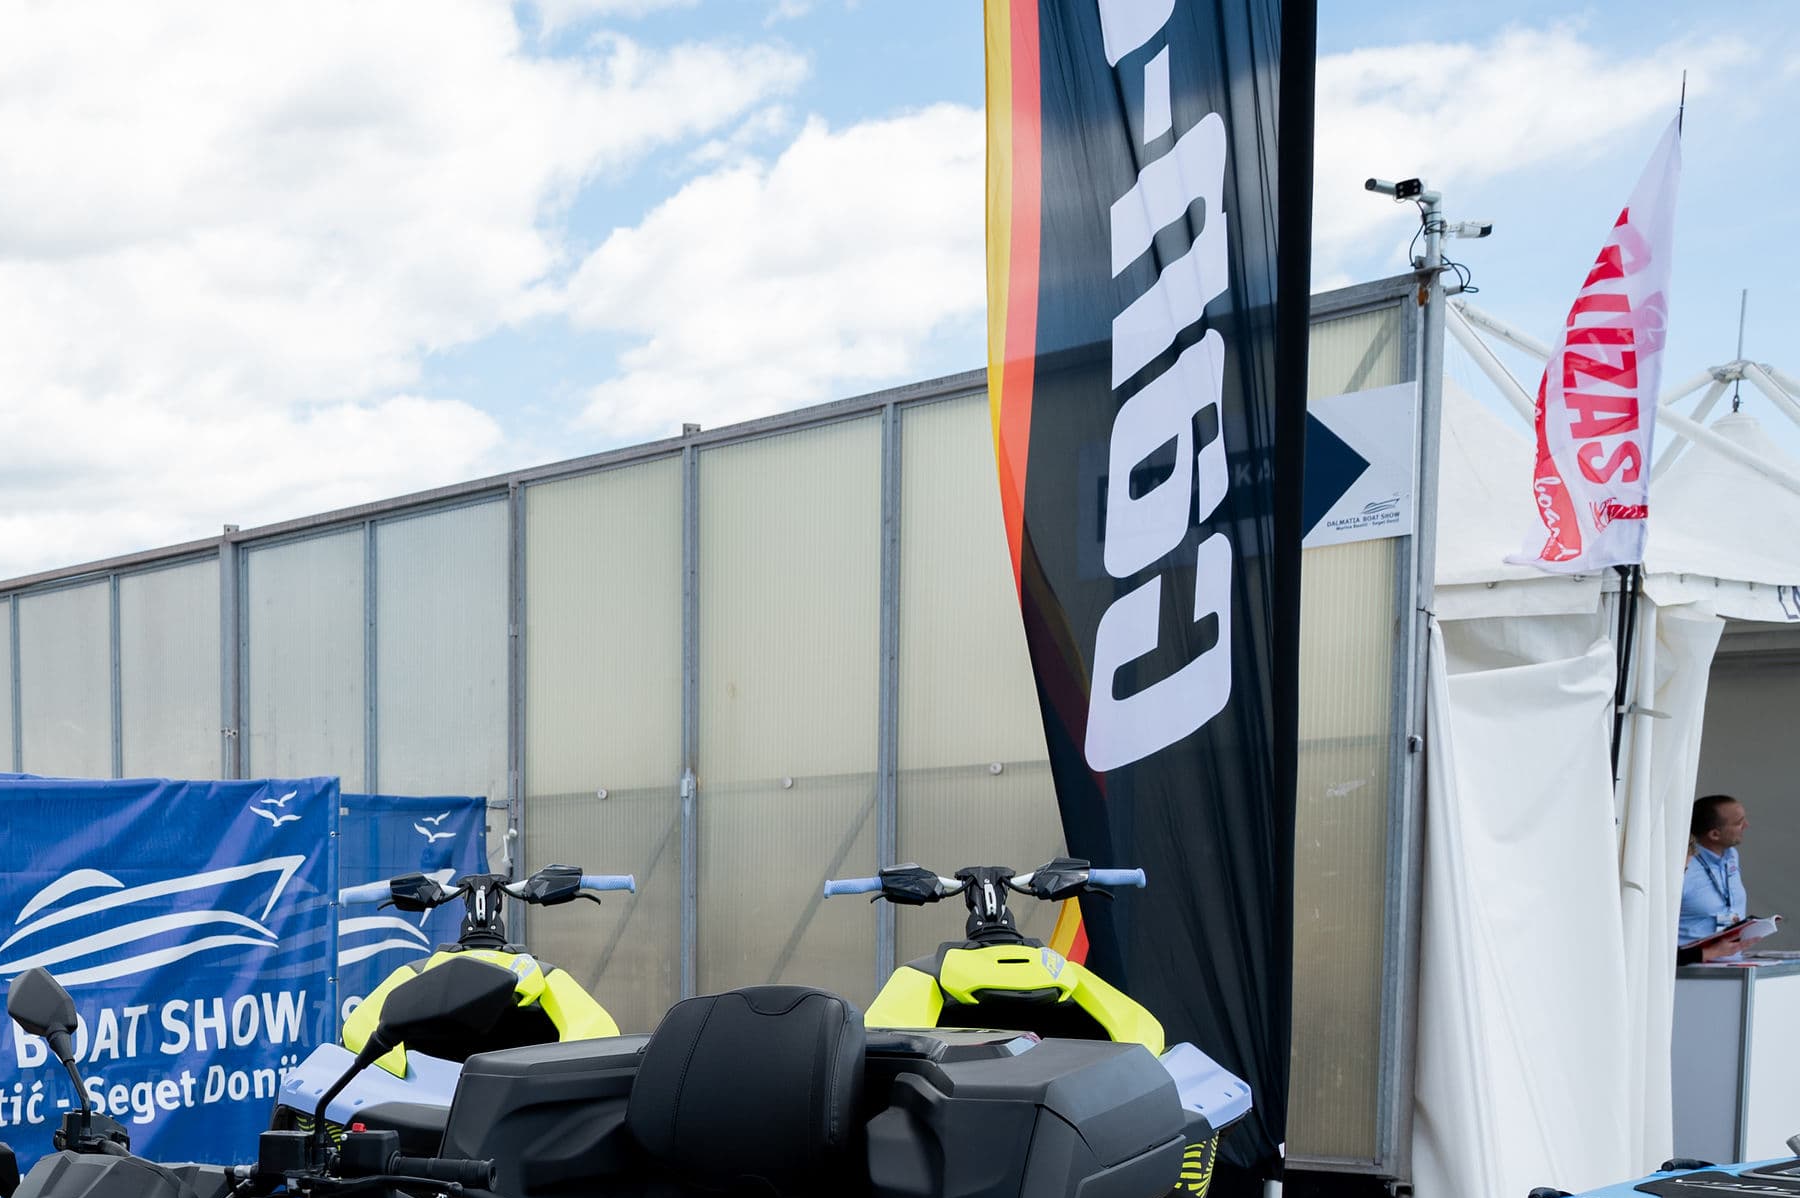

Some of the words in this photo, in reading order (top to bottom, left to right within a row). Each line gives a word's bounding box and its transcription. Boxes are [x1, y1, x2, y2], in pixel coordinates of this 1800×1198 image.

[1562, 206, 1644, 485] ALIZAS
[1084, 0, 1232, 772] can-
[1326, 517, 1360, 528] DALMATIA
[1362, 514, 1379, 522] BOAT
[1381, 512, 1400, 520] SHOW
[159, 990, 306, 1056] SHOW
[85, 1069, 197, 1125] Seget
